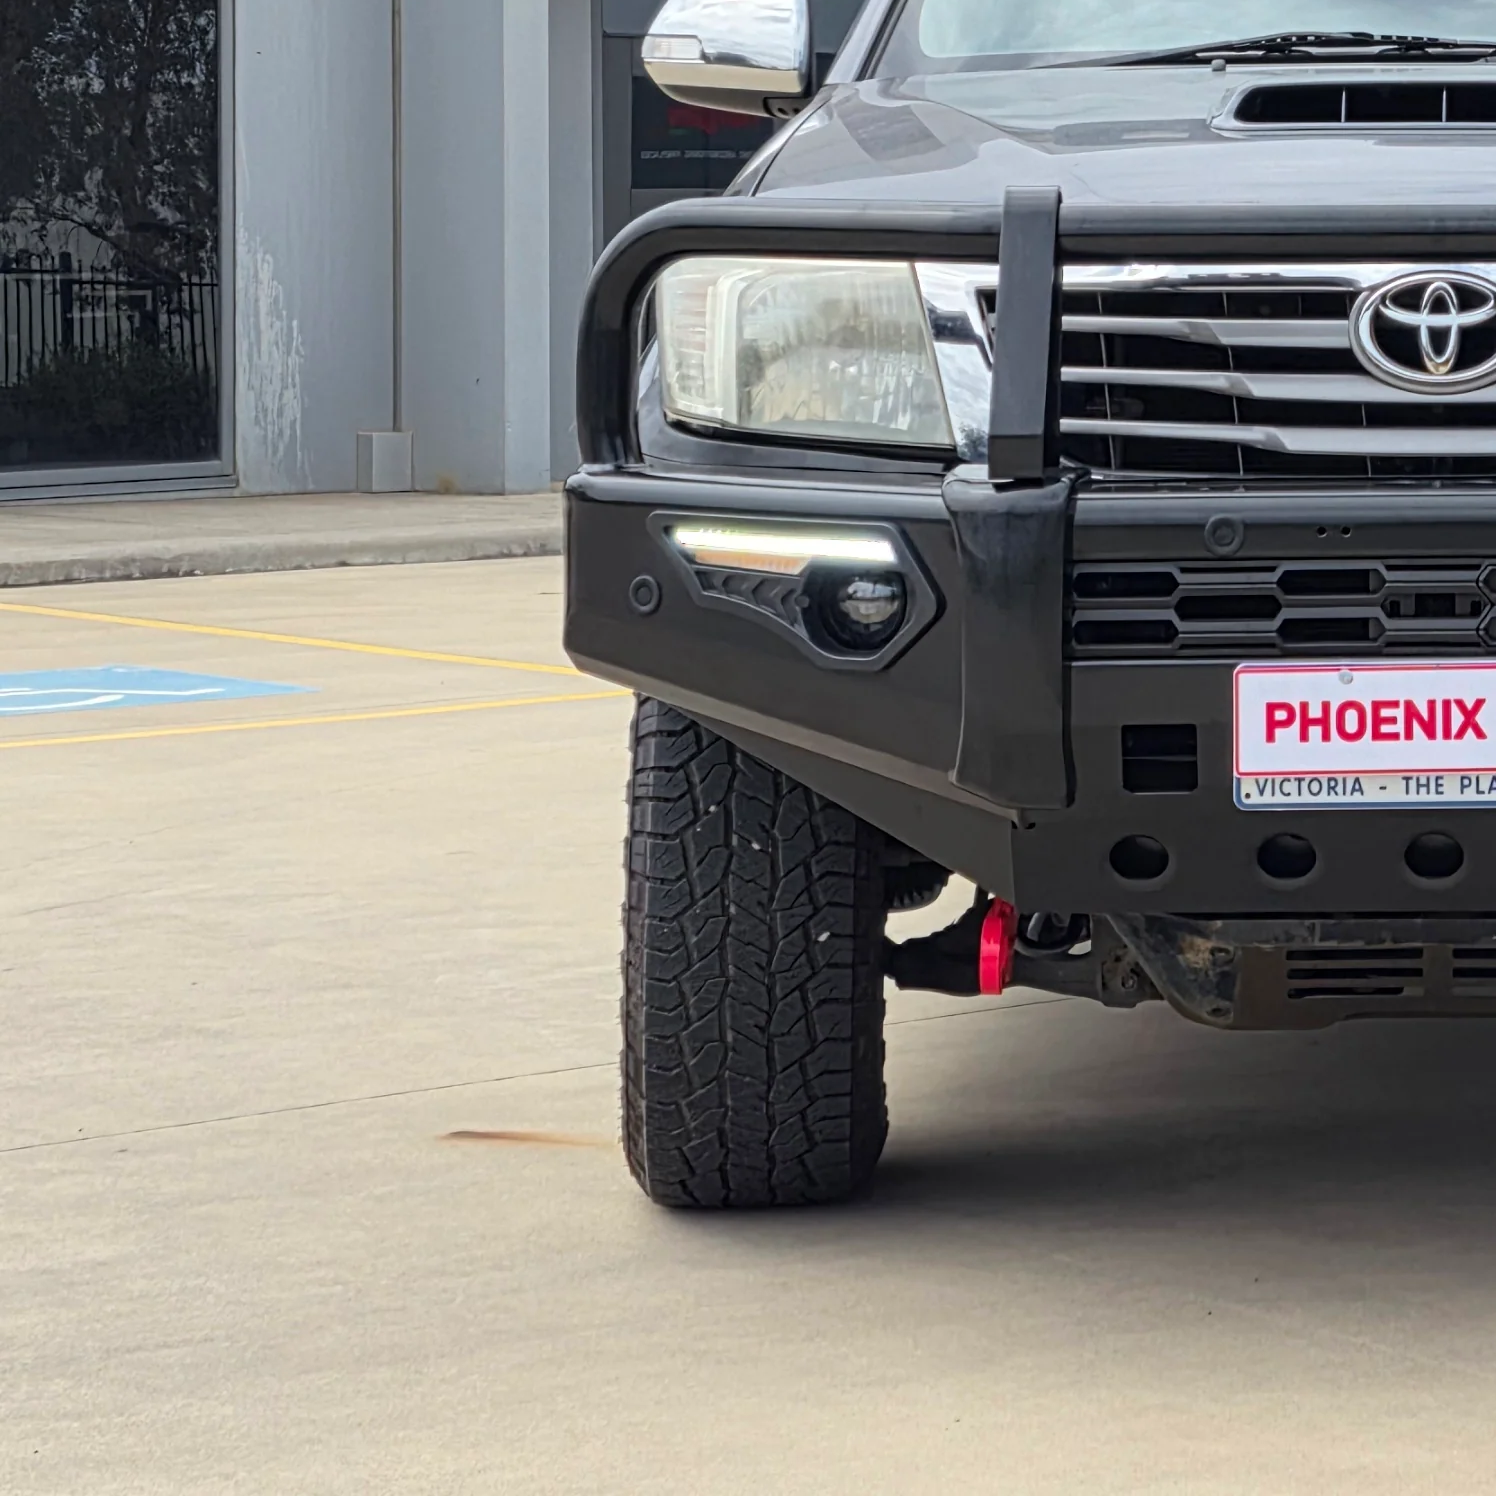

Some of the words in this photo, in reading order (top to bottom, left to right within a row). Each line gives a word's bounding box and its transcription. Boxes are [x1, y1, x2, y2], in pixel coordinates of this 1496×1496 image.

[1265, 698, 1488, 744] PHOENIX
[1254, 776, 1365, 798] VICTORIA
[1401, 775, 1445, 796] THE
